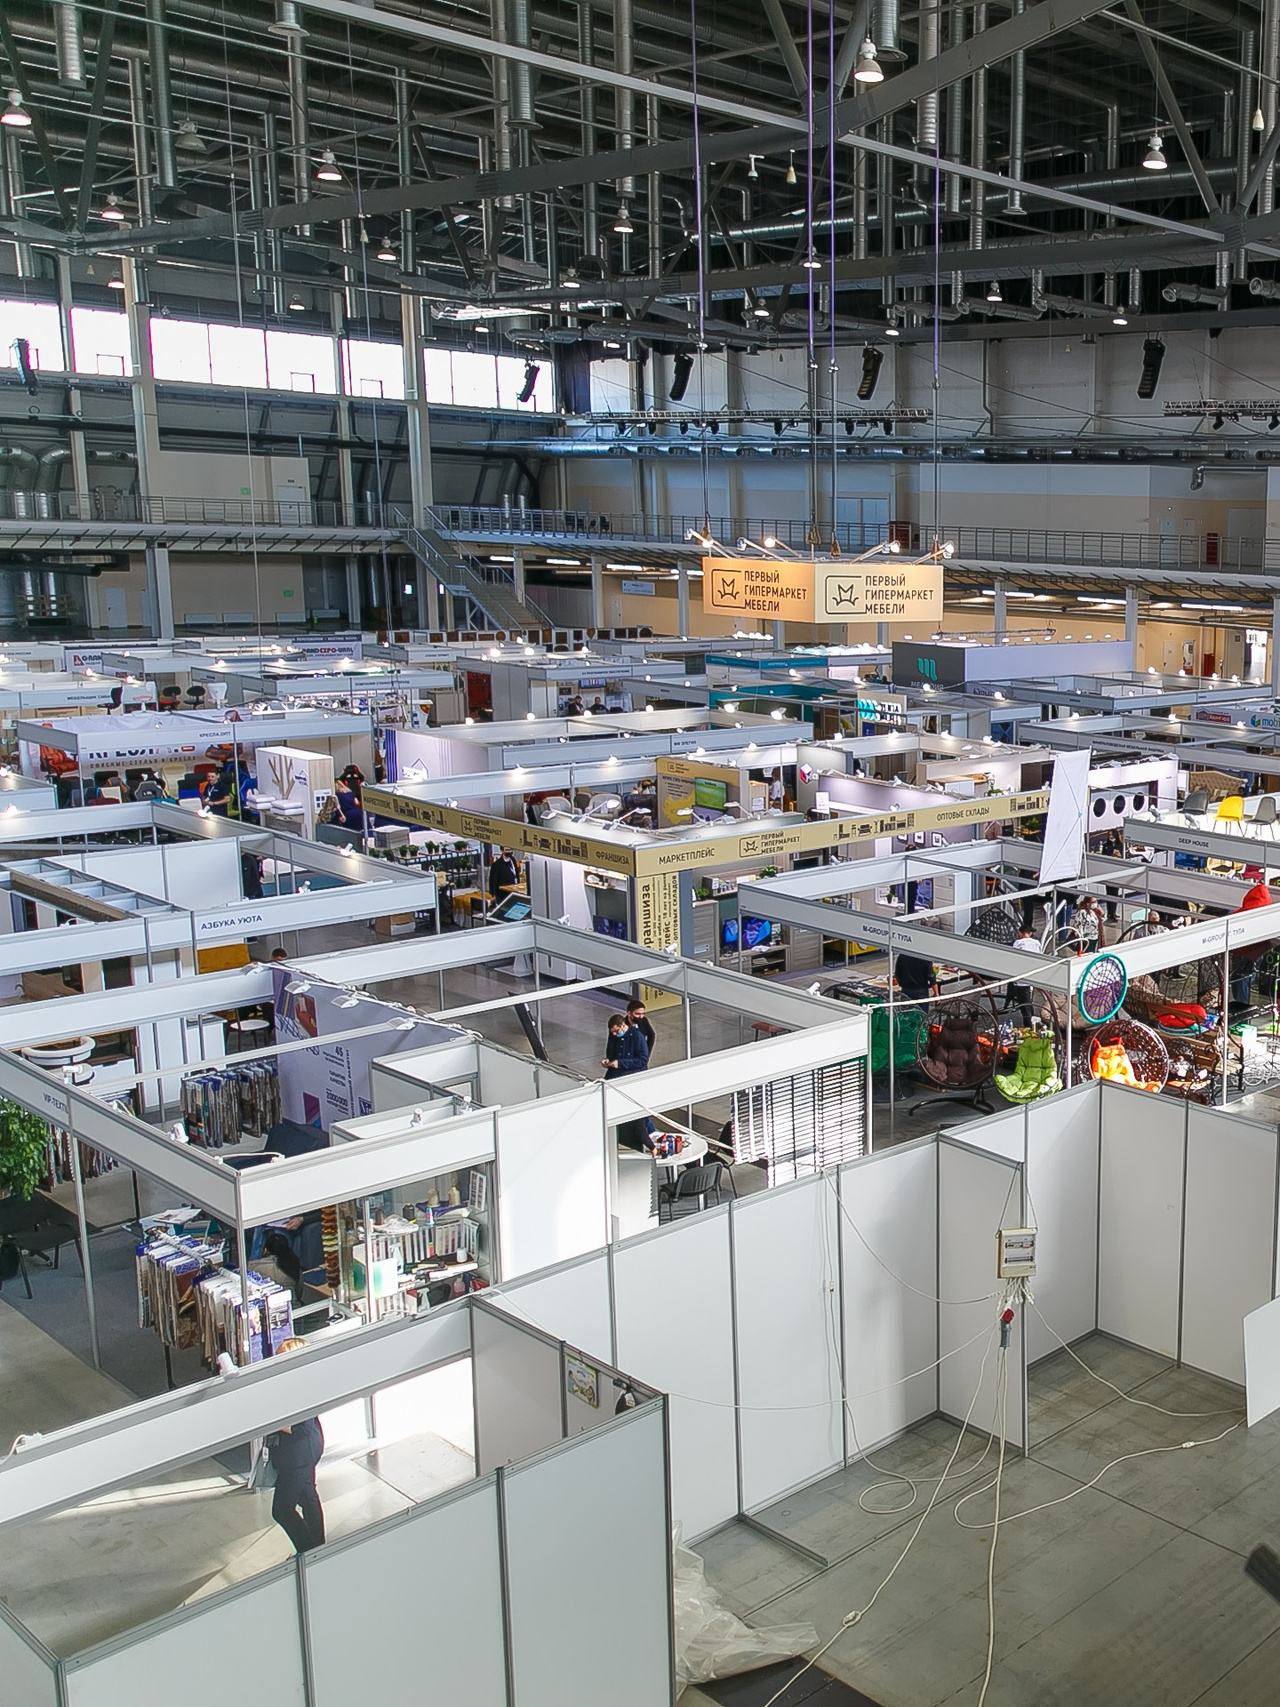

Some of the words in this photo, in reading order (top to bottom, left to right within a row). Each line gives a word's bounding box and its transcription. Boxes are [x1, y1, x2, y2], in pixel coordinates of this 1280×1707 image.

[744, 570, 780, 584] ПЕРВЫЙ
[865, 574, 906, 587] ПЕРВЫЙ
[744, 585, 807, 600] ГИПЕРМАРКЕТ
[865, 589, 934, 601] ГИПЕРМАРКЕТ
[744, 599, 780, 612] МЕБЕЛИ
[865, 603, 905, 615] МЕБЕЛИ
[1261, 717, 1280, 728] mobi
[937, 810, 964, 821] ОПТОВЫЕ
[966, 807, 990, 817] СКЛАДЫ
[474, 818, 490, 826] ПЕРВЫЙ
[474, 825, 502, 836] ГИПЕРМАРКЕТ
[761, 831, 784, 840] ПЕРВЫЙ
[761, 836, 800, 847] ГИПЕРМАРКЕТ
[1178, 837, 1191, 846] DEEP
[1192, 839, 1209, 848] HOUSE
[659, 847, 715, 865] МАРКЕТПЛЕЙС
[761, 846, 784, 854] МЕБЕЛИ
[595, 849, 630, 865] ФРАНШИЗА
[641, 884, 654, 948] раншиза
[201, 919, 235, 930] АЗБУКА
[238, 915, 262, 924] УЮТА
[863, 925, 889, 936] M-GROUP
[1233, 928, 1245, 936] ТУЛА
[898, 933, 912, 942] ТУЛА
[1202, 932, 1225, 944] M-GROUP
